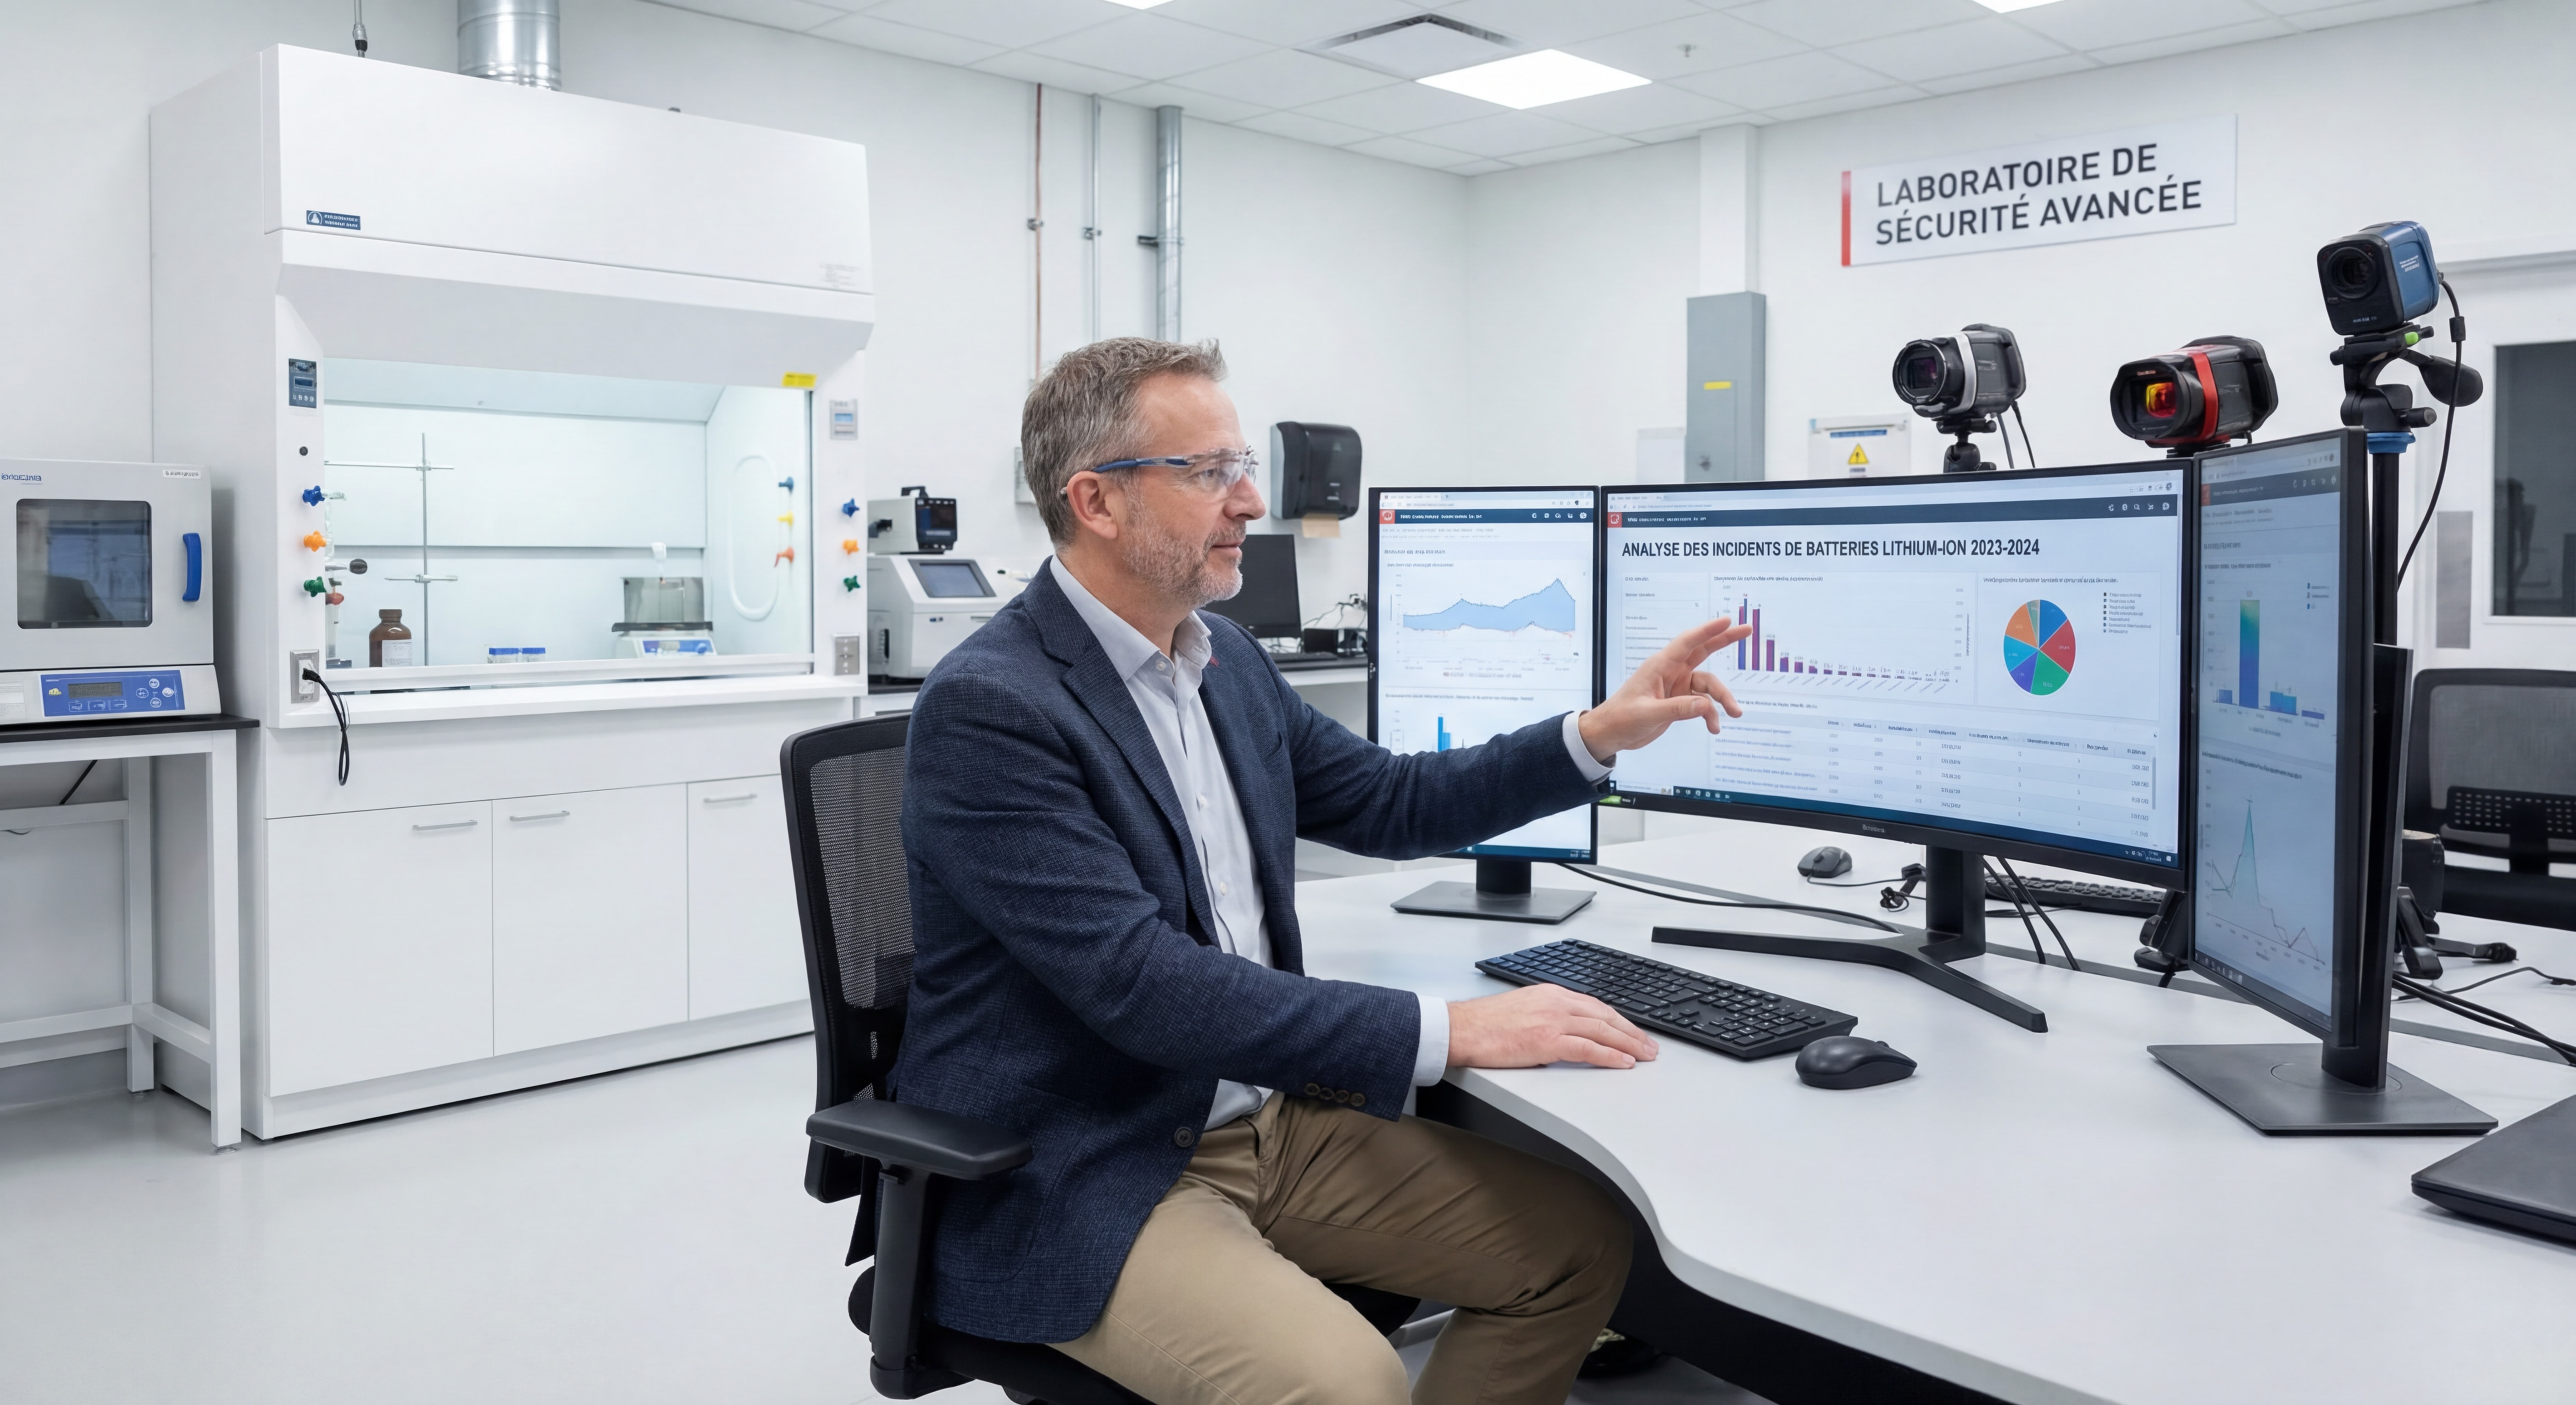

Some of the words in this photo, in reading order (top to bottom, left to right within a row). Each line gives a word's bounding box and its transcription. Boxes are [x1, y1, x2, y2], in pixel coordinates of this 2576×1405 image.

[1878, 151, 2100, 207] LABORATOIRE
[2113, 143, 2157, 177] DE
[1876, 193, 2030, 246] SÉCURITÉ
[2039, 174, 2202, 232] AVANCÉE
[1622, 542, 1680, 557] ANALYSE
[1683, 542, 1709, 557] DES
[1712, 541, 1782, 557] INCIDENTS
[1785, 541, 1803, 556] DE
[1806, 541, 1879, 556] BATTERIES
[1883, 540, 1967, 556] LITHIUM-ION
[1970, 539, 2040, 556] 2023-2024
